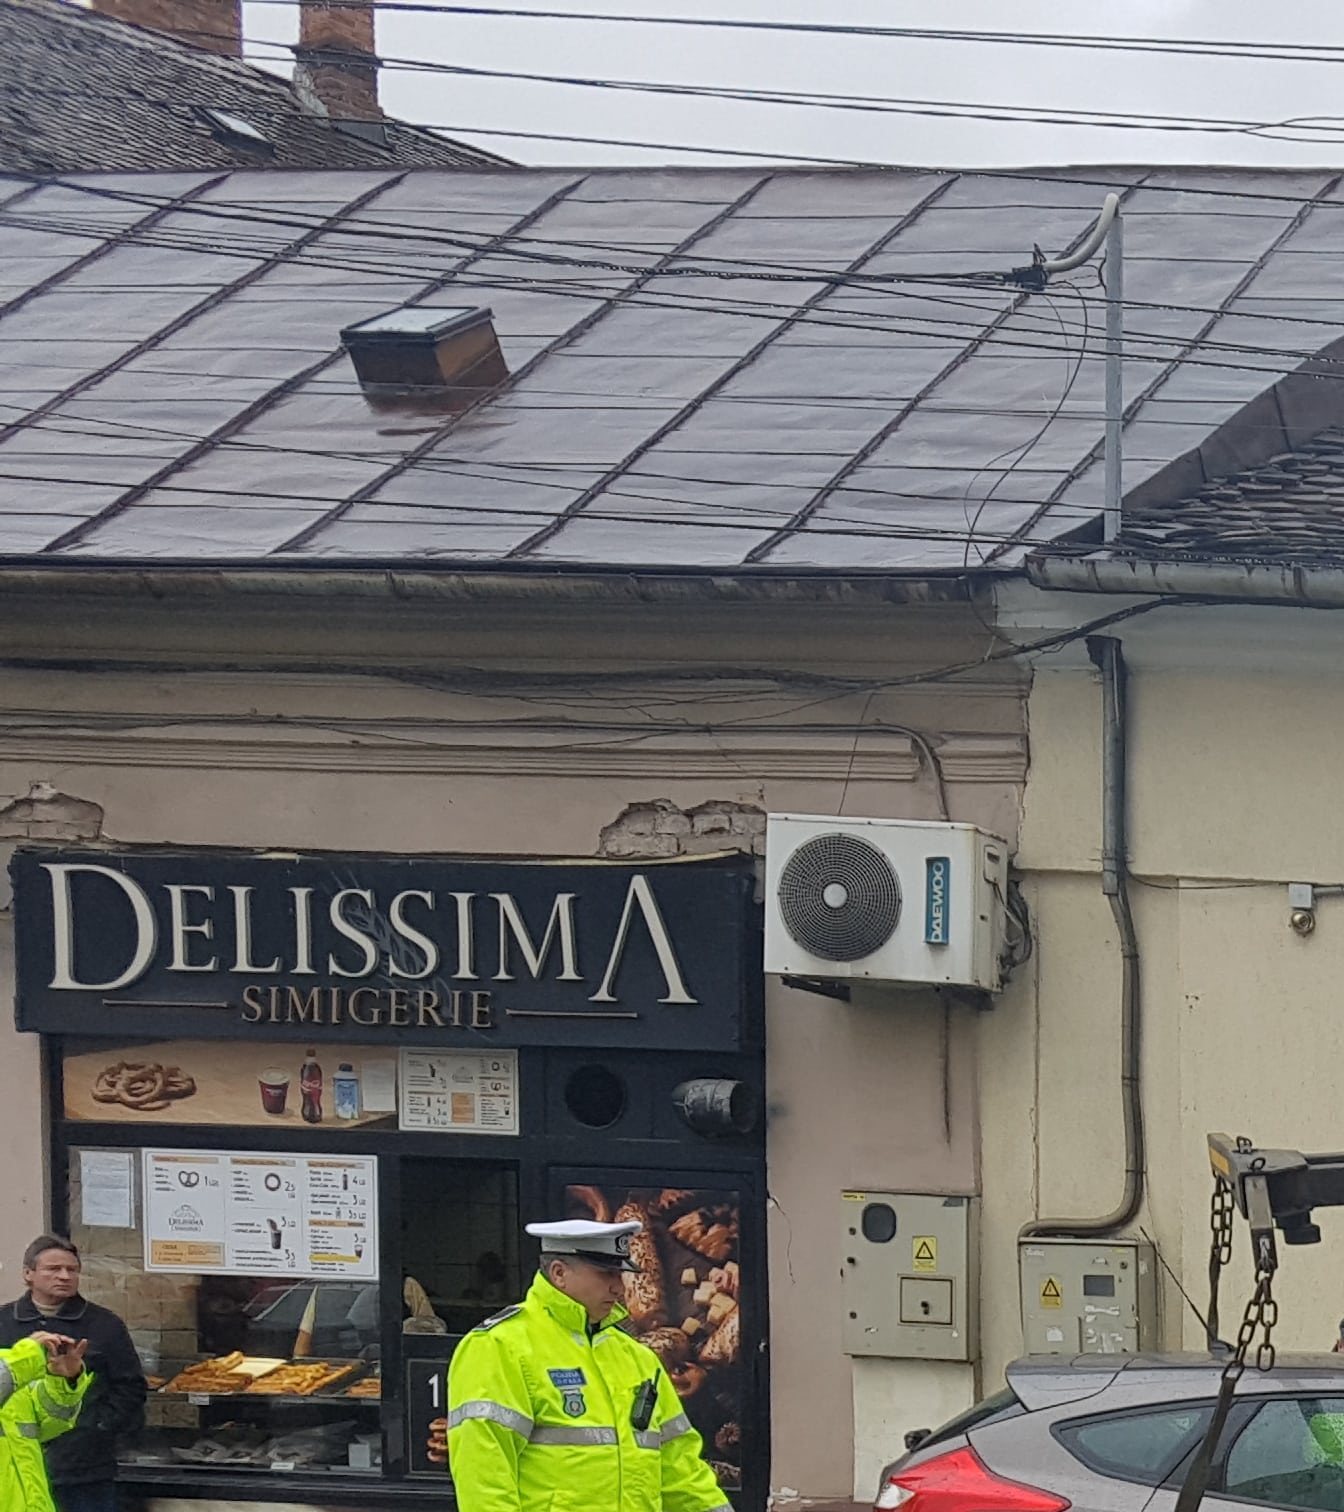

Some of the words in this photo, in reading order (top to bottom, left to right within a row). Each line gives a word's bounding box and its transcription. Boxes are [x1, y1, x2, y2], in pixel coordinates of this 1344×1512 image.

[39, 862, 699, 1004] DELISSIMA
[931, 862, 944, 943] DAEWOO
[241, 985, 493, 1028] SIMIGERIE
